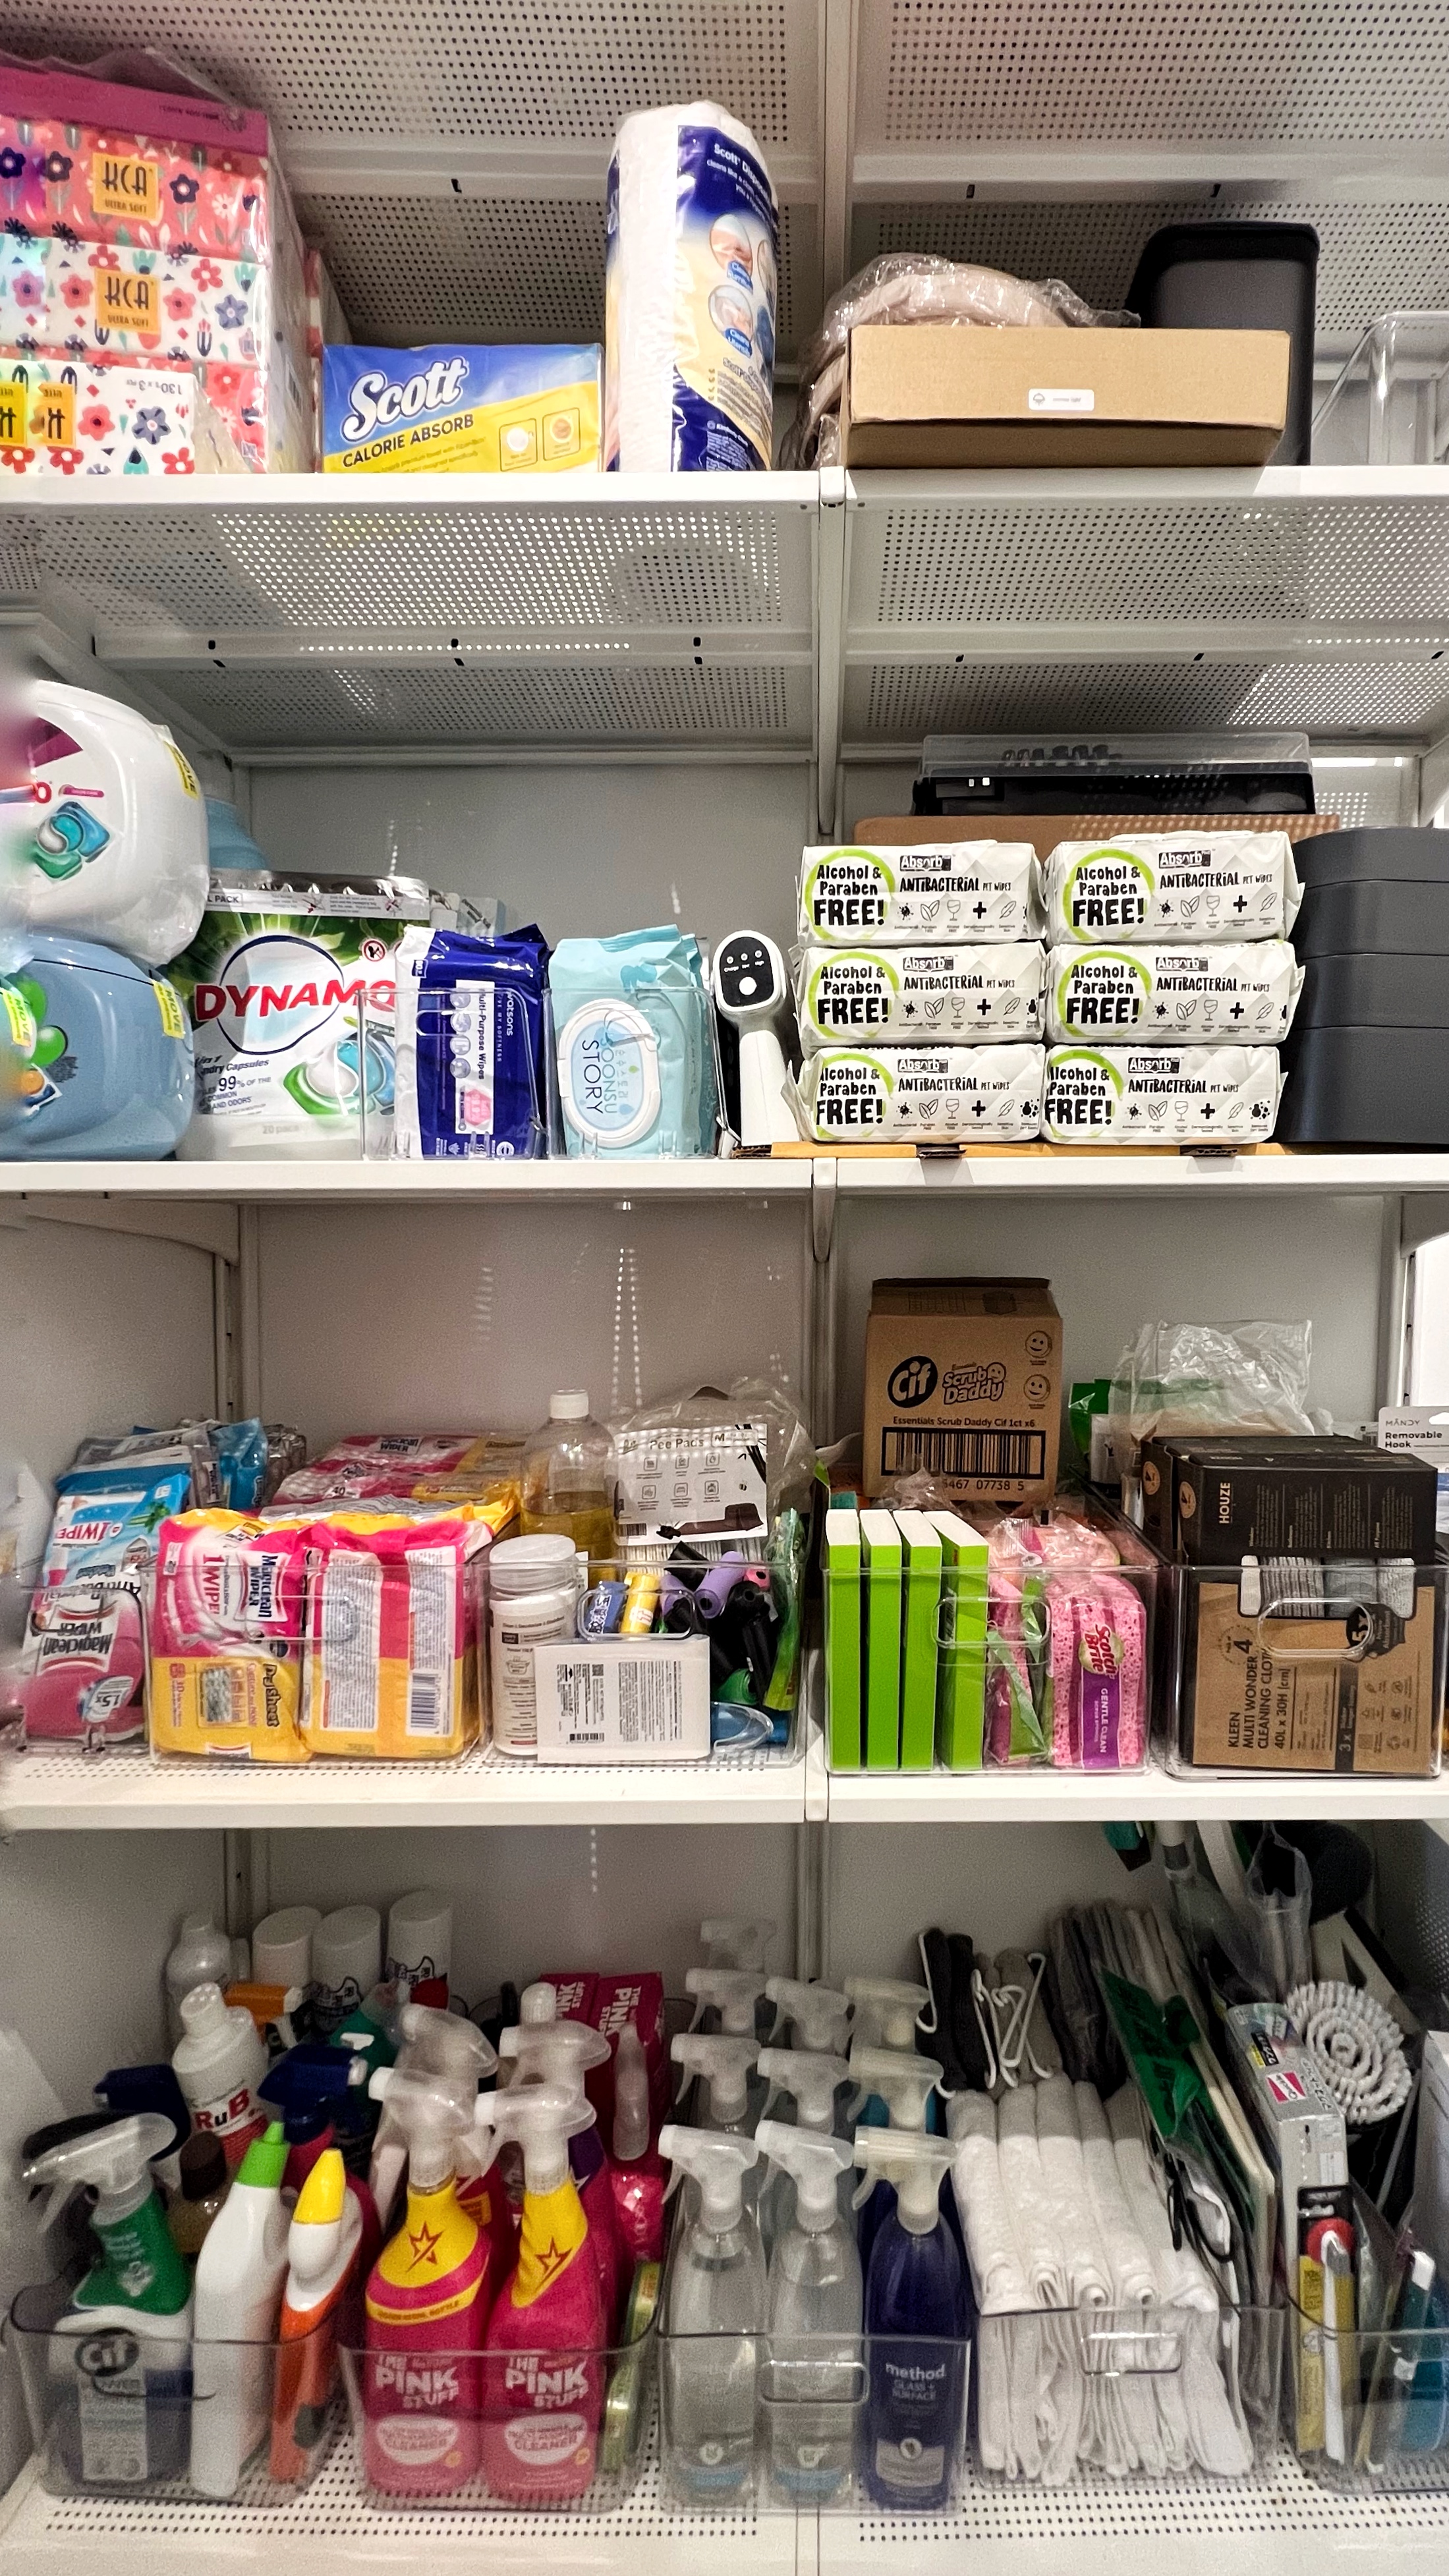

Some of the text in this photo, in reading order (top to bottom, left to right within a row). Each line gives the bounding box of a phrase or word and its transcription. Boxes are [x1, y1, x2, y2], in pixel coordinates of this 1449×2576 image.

[102, 161, 147, 196] KCA
[104, 276, 149, 310] KCA
[339, 356, 470, 442] Scott
[342, 435, 405, 468] CALORIE
[410, 414, 474, 446] ABSORB
[901, 855, 943, 868] Absorb
[1160, 851, 1203, 865] Absorb
[816, 865, 882, 879] Alcohol &
[1076, 864, 1141, 880] Alcohol &
[820, 881, 878, 895] Paraben
[1079, 880, 1137, 896] Paraben
[219, 895, 239, 903] PACK
[814, 899, 884, 926] FREE!
[1073, 899, 1144, 927] FREE!
[820, 966, 885, 979] Alcohol &
[904, 957, 945, 970] Absorb
[1071, 965, 1139, 979] Alcohol &
[1157, 957, 1199, 970] Absorb
[824, 980, 882, 995] Paraben
[1074, 979, 1134, 994] Paraben
[195, 979, 395, 1021] DYNAMO
[817, 997, 889, 1024] FREE!
[1065, 997, 1140, 1024] FREE!
[226, 1059, 270, 1071] Capsules
[477, 1053, 486, 1080] Wipes
[870, 1067, 880, 1080] &
[899, 1059, 940, 1071] Absorb
[1100, 1067, 1110, 1080] &
[1129, 1058, 1172, 1070] Absorb
[582, 1040, 604, 1114] STORY
[820, 1081, 877, 1096] Paraben
[1049, 1081, 1107, 1096] Paraben
[816, 1098, 883, 1125] FREE!
[1044, 1098, 1113, 1125] FREE!
[892, 1361, 931, 1401] Cif
[943, 1366, 988, 1387] Scrub
[944, 1381, 1004, 1405] Daddy
[893, 1416, 934, 1426] Essentials
[937, 1417, 962, 1426] Scrub
[964, 1418, 992, 1428] Daddy
[994, 1418, 1007, 1427] Cif
[650, 1439, 671, 1449] Pee
[1385, 1431, 1442, 1440] Removable
[976, 1480, 1011, 1490] 07738
[1017, 1481, 1025, 1490] 5
[1218, 1482, 1232, 1524] HOUZE
[42, 1633, 113, 1657] Magiclean
[1085, 1633, 1104, 1673] Brite
[1096, 1623, 1117, 1675] Scotch
[1233, 1638, 1253, 1654] 4
[1243, 1656, 1258, 1749] MULTI WONDER
[1257, 1648, 1273, 1749] CLEANING CLOTH
[1276, 1693, 1288, 1716] 30H
[1100, 1725, 1108, 1753] CLEAN
[1228, 1712, 1241, 1748] KLEEN
[1274, 1729, 1286, 1749] 40L
[1339, 1743, 1351, 1752] 3
[599, 2005, 611, 2032] STU
[605, 1987, 633, 2037] PINK
[376, 2366, 457, 2394] PINK
[504, 2355, 587, 2395] PINK
[885, 2363, 946, 2381] method
[403, 2387, 459, 2408] STUFF
[534, 2386, 589, 2409] STUFF
